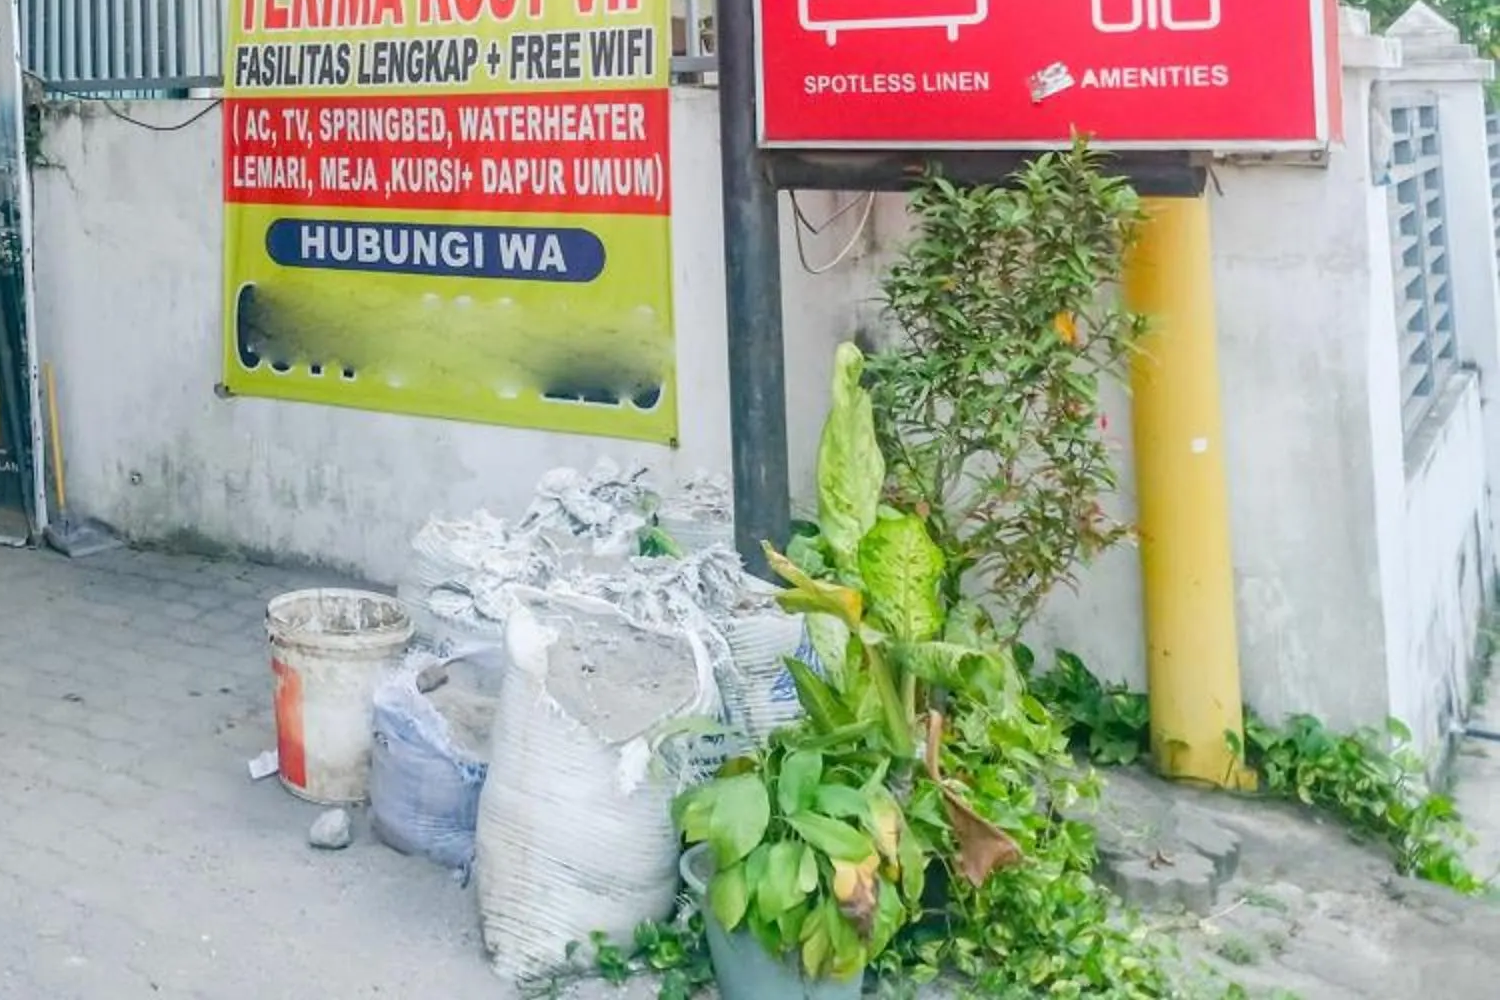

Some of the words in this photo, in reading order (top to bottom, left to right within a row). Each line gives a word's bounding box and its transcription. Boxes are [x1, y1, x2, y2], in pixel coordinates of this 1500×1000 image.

[235, 42, 351, 88] FASILITAS
[357, 36, 479, 85] LENGKAP
[510, 31, 582, 81] FREE
[589, 27, 655, 77] WIFI
[1080, 64, 1230, 89] AMENITIES
[802, 72, 917, 95] SPOTLESS
[922, 70, 991, 93] LINEN
[319, 105, 453, 148] SPRINGBED,
[459, 102, 647, 142] WATERHEATER
[232, 155, 314, 198] LEMARI,
[481, 156, 567, 194] DAPUR
[573, 153, 664, 202] UMUM)
[300, 224, 484, 270] HUBUNGI
[499, 231, 568, 273] WA
